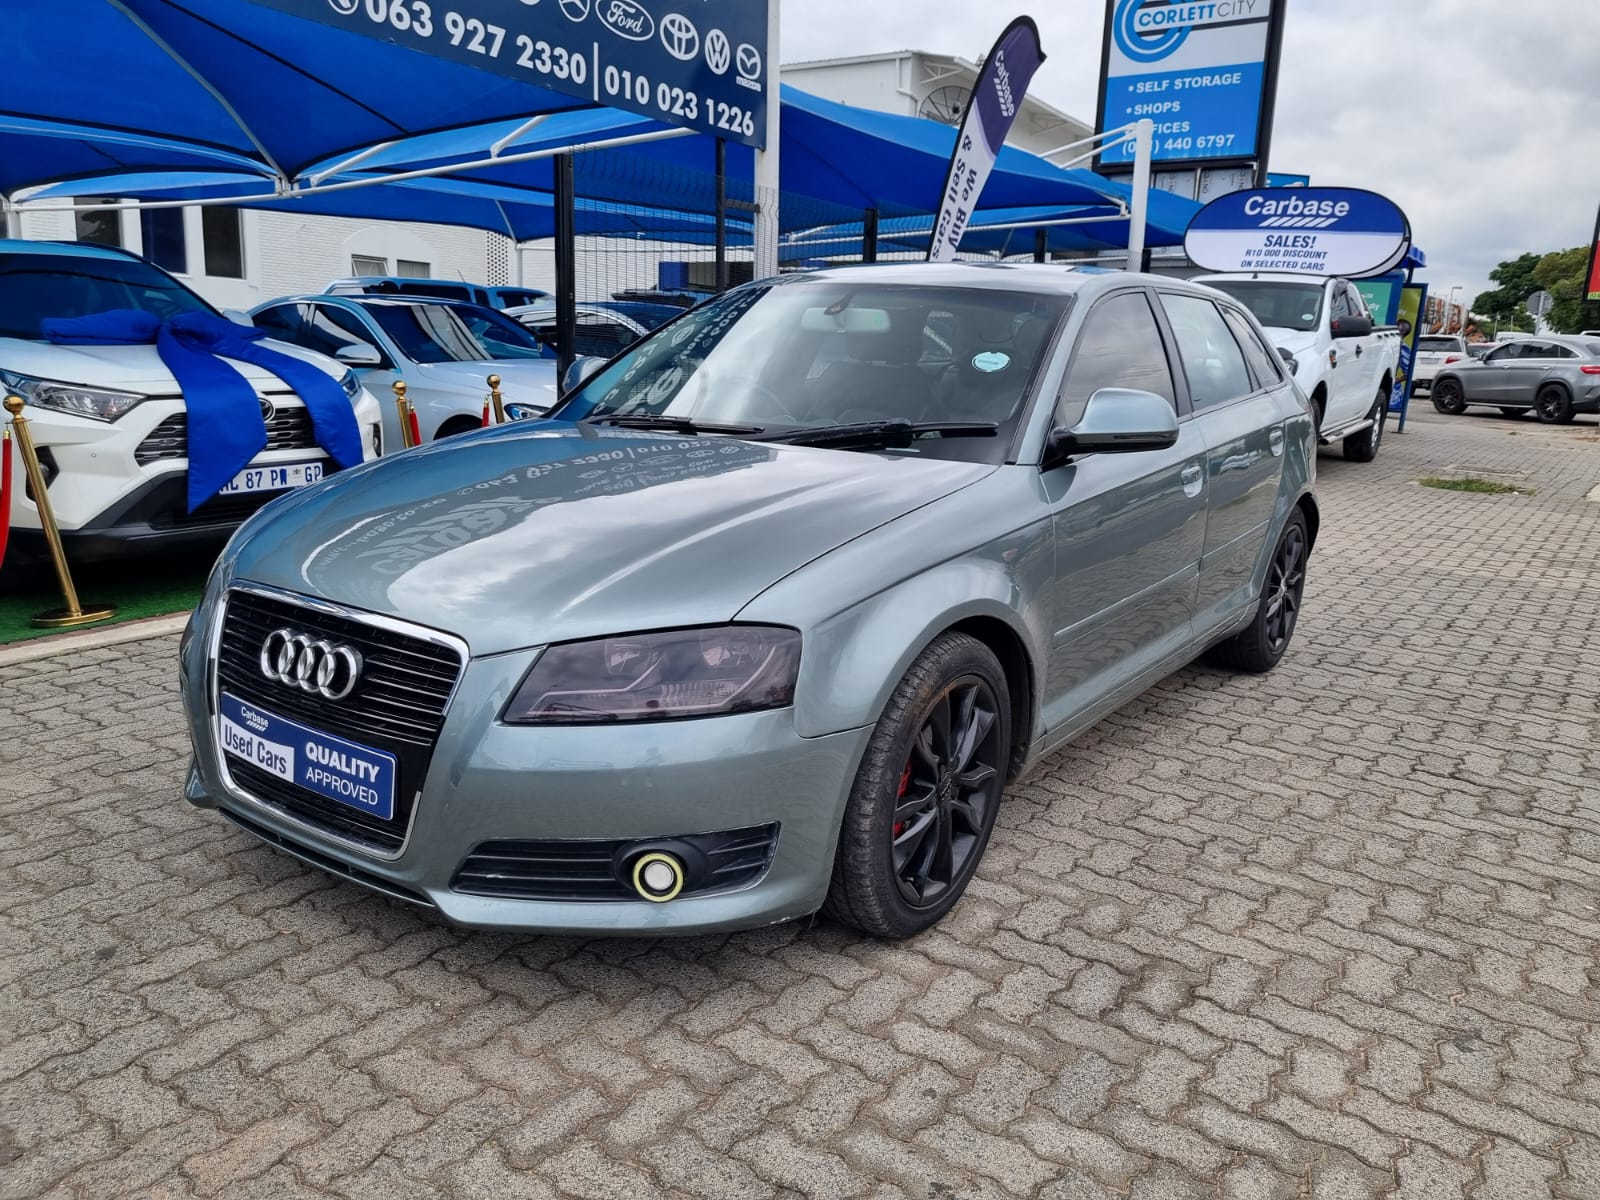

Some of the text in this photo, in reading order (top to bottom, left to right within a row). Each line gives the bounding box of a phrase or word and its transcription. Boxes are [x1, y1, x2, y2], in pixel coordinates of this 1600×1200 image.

[607, 1, 644, 33] Ford
[365, 0, 433, 37] 063
[445, 11, 506, 58] 927
[516, 34, 587, 84] 2330
[604, 65, 649, 105] 010
[657, 82, 698, 120] 023
[705, 98, 754, 137] 1226
[995, 50, 1015, 117] Carbase
[1136, 72, 1242, 93] SELF STORAGE
[1133, 101, 1181, 115] SHOPS
[1152, 121, 1190, 134] FICES
[1122, 134, 1235, 157] (0) 440 6797
[932, 134, 972, 259] & Sell Cars
[1244, 195, 1350, 217] Carbase
[948, 168, 977, 250] We Buy
[1264, 234, 1317, 249] SALES!
[1240, 260, 1325, 271] ON SELECTED CARS
[1245, 249, 1328, 260] R10 000 DISCOUNT
[246, 471, 263, 489] 87
[304, 465, 321, 483] GP
[241, 706, 269, 728] Carbase
[225, 724, 287, 774] Used Cars
[305, 742, 380, 783] QUALITY
[305, 766, 378, 806] APPROVED
